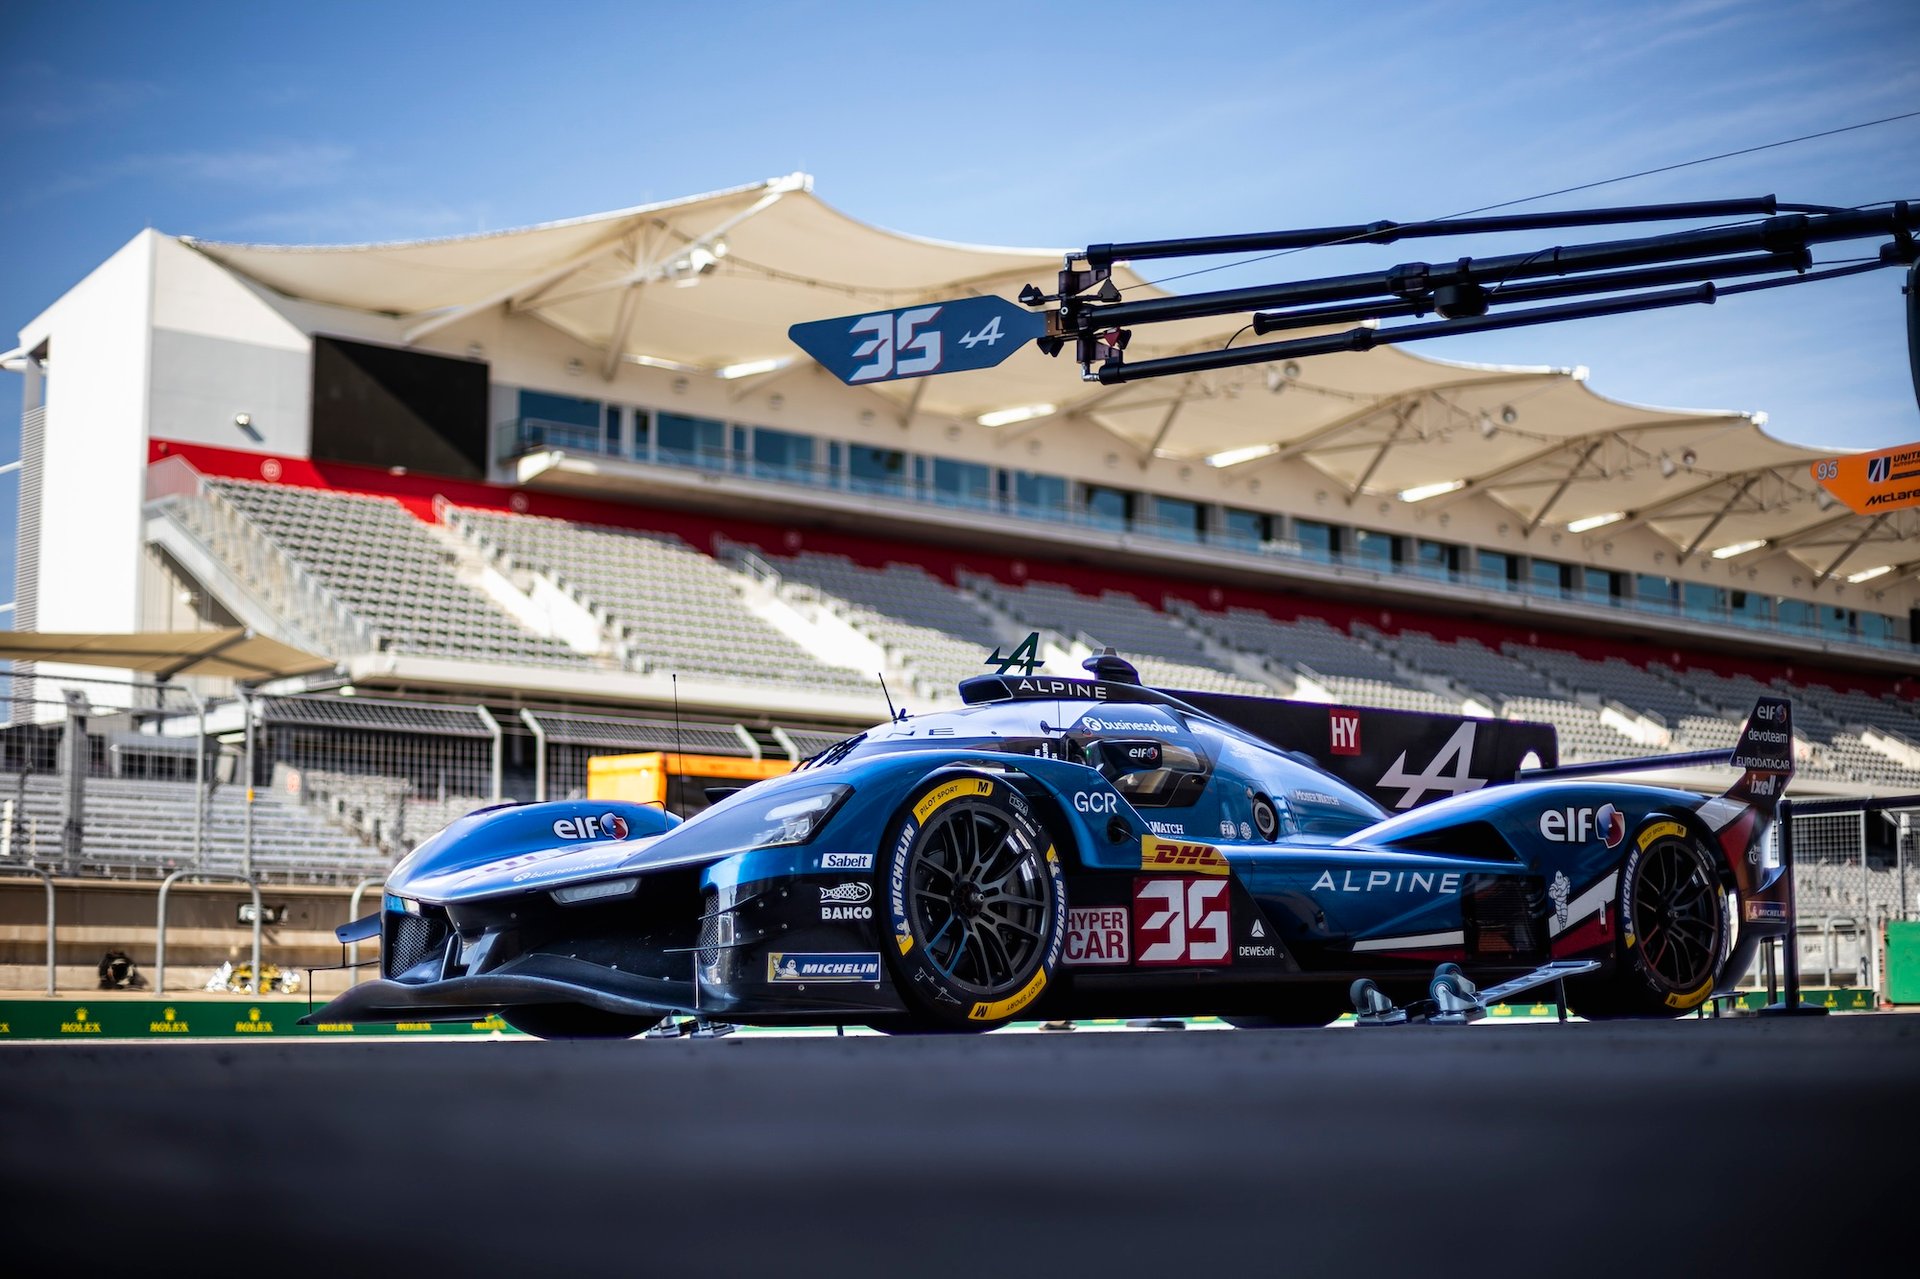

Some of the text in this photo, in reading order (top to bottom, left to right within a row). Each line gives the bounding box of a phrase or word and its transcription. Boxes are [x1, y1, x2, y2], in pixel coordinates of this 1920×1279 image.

[849, 306, 942, 382] 35
[1817, 461, 1839, 480] 95
[1018, 679, 1107, 699] ALPINE
[1757, 705, 1775, 720] elf
[1100, 718, 1179, 734] businessolver
[1331, 716, 1358, 748] HY
[1748, 728, 1788, 743] devoteam
[1128, 747, 1147, 759] elf
[1736, 756, 1790, 769] EURODATACAR
[1750, 773, 1776, 795] ixell
[919, 780, 988, 816] PILOT SPORT M
[1074, 791, 1118, 814] GCR
[553, 816, 599, 839] elf
[1150, 821, 1184, 835] WATCH
[1540, 807, 1592, 842] elf
[827, 854, 867, 867] Sabelt
[1154, 844, 1218, 866] DHL
[893, 823, 915, 916] MICHELIN
[1310, 870, 1460, 894] ALPINE
[1622, 850, 1638, 918] MICHELIN
[821, 906, 872, 919] BAHCO
[1068, 911, 1124, 930] HYPER
[1136, 880, 1230, 961] 35
[1048, 880, 1065, 969] MICHELIN
[1064, 930, 1125, 959] CAR
[1239, 946, 1275, 957] DEWESoft
[801, 963, 877, 973] MICHELIN
